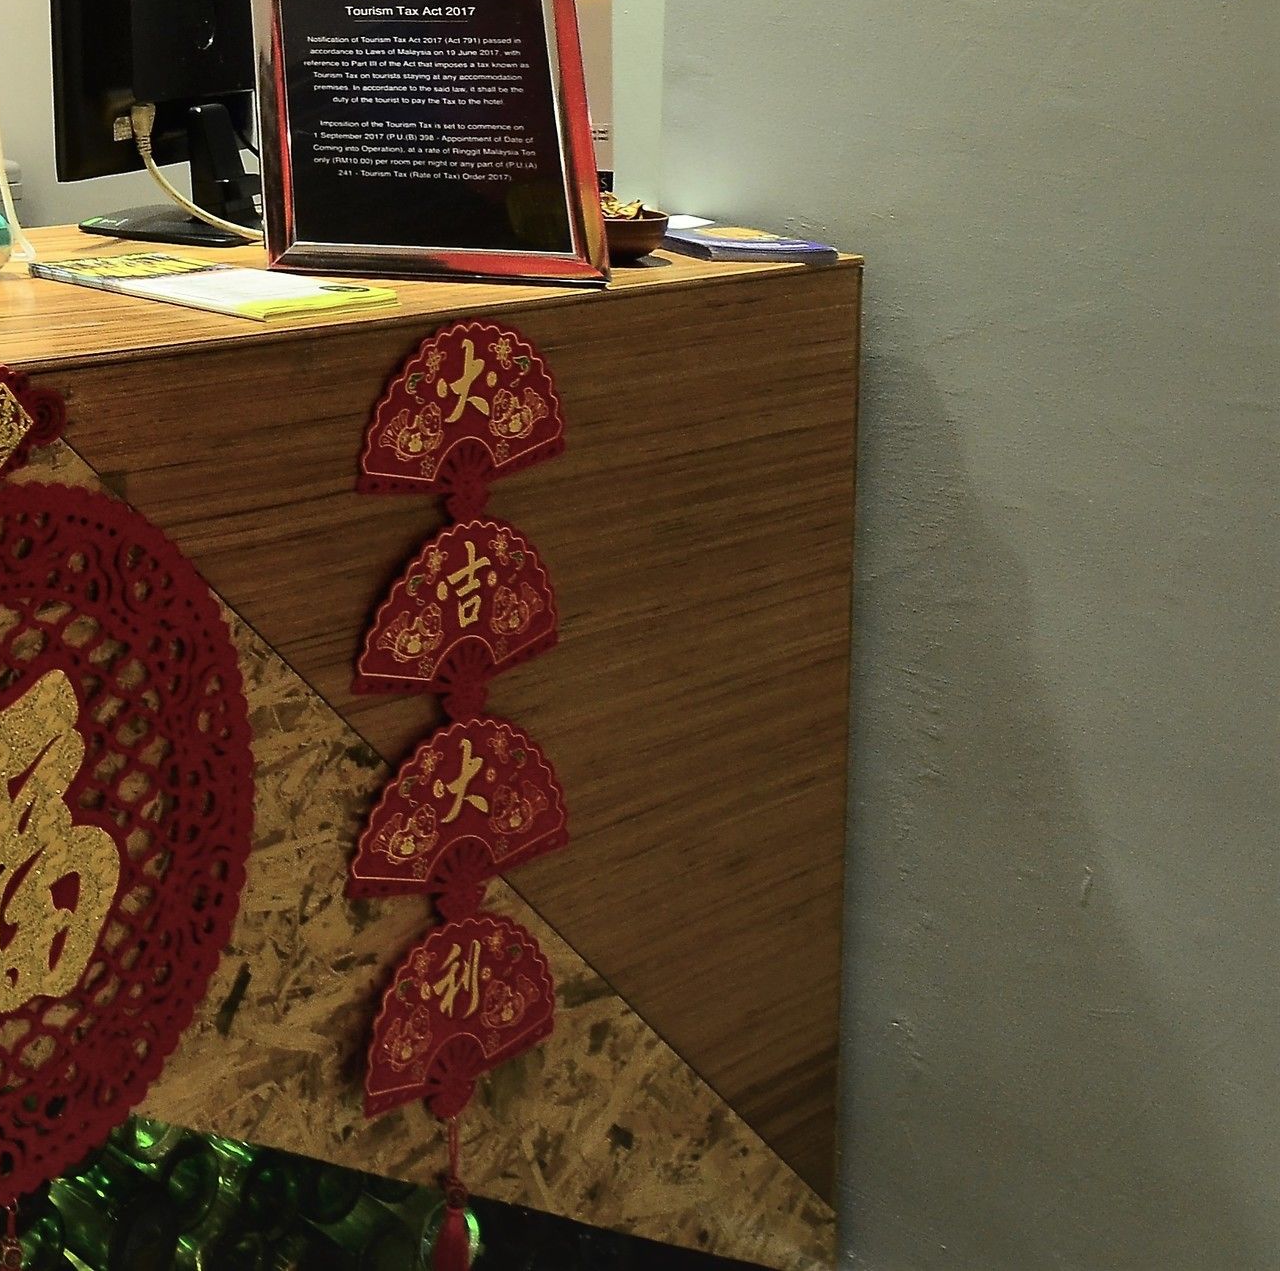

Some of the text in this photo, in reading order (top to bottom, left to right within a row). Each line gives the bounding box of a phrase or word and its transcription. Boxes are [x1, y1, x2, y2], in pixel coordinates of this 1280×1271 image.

[344, 6, 476, 16] Tourism Tax Act 2017
[442, 339, 491, 424] 大
[445, 542, 491, 629] 吉
[440, 738, 490, 824] 大
[435, 941, 482, 1020] 利
